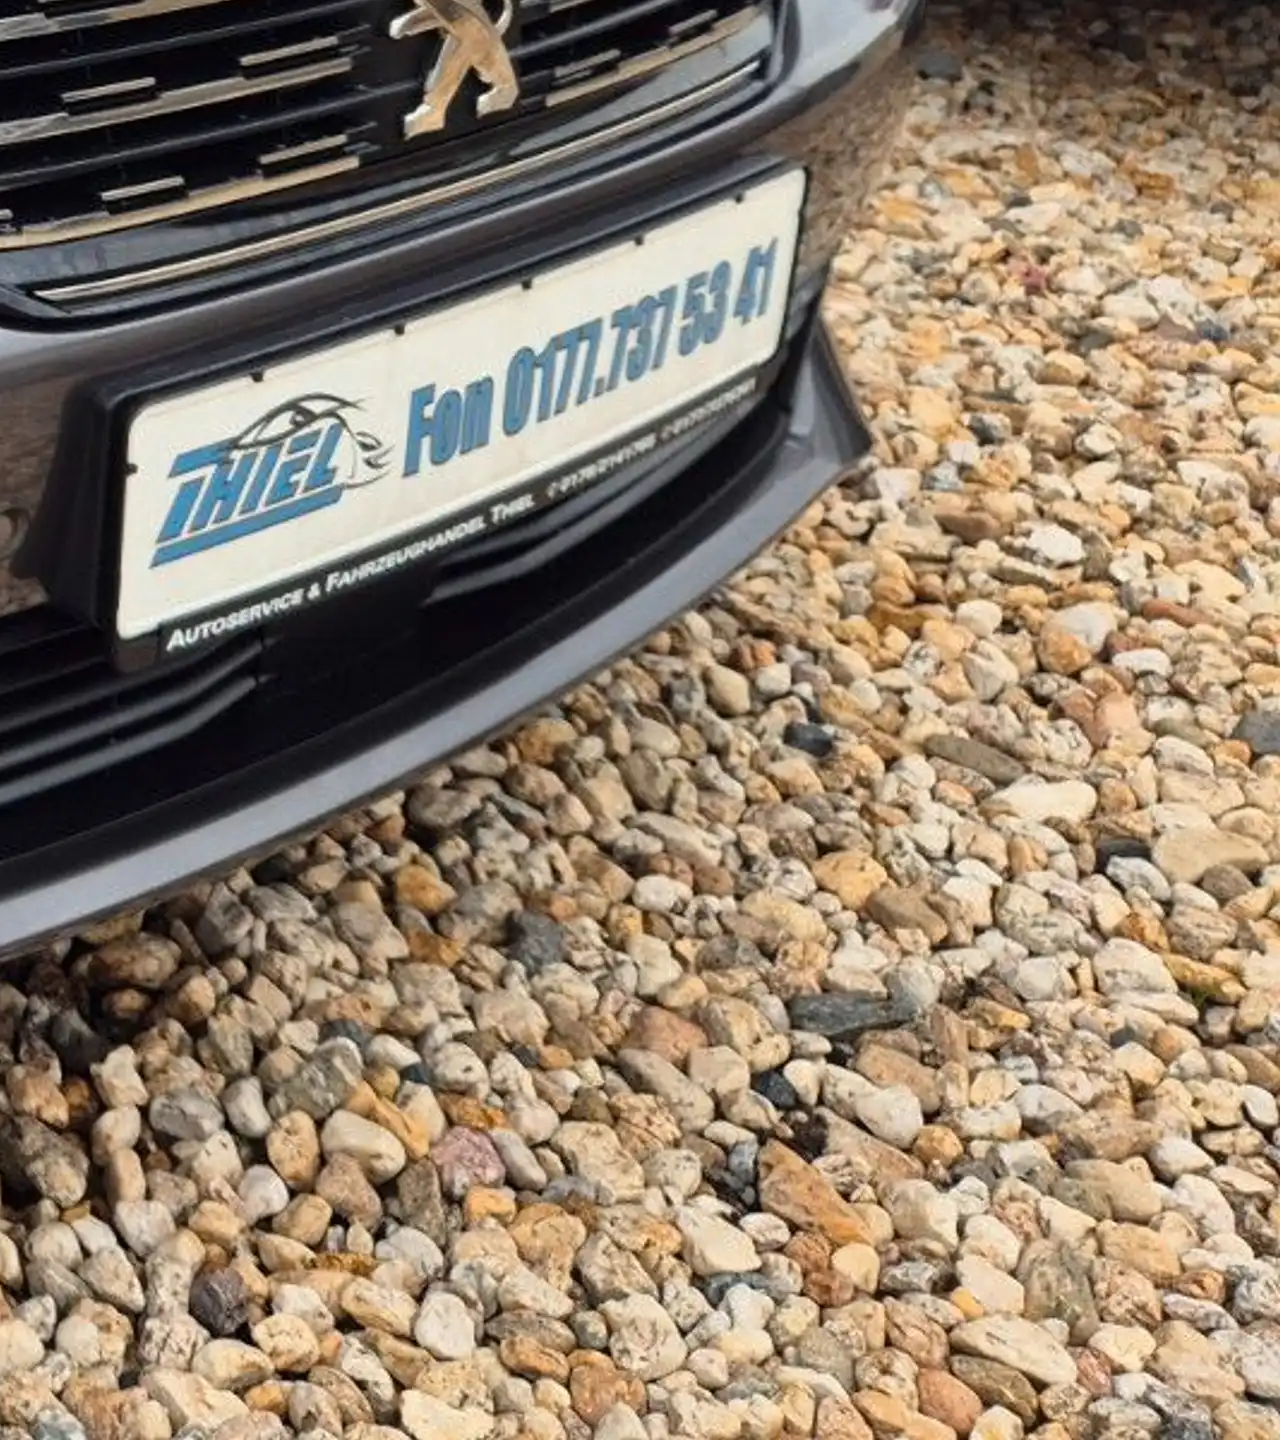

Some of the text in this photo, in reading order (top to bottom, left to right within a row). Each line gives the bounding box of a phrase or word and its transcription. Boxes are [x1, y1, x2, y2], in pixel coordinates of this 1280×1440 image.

[155, 422, 344, 545] THIEL
[401, 375, 494, 477] Fon
[503, 286, 679, 436] 0177.737
[677, 260, 732, 356] 53
[734, 236, 779, 325] 41
[165, 493, 536, 653] AUTOSERVICE & FAHRZEUGHANDEL THIEL
